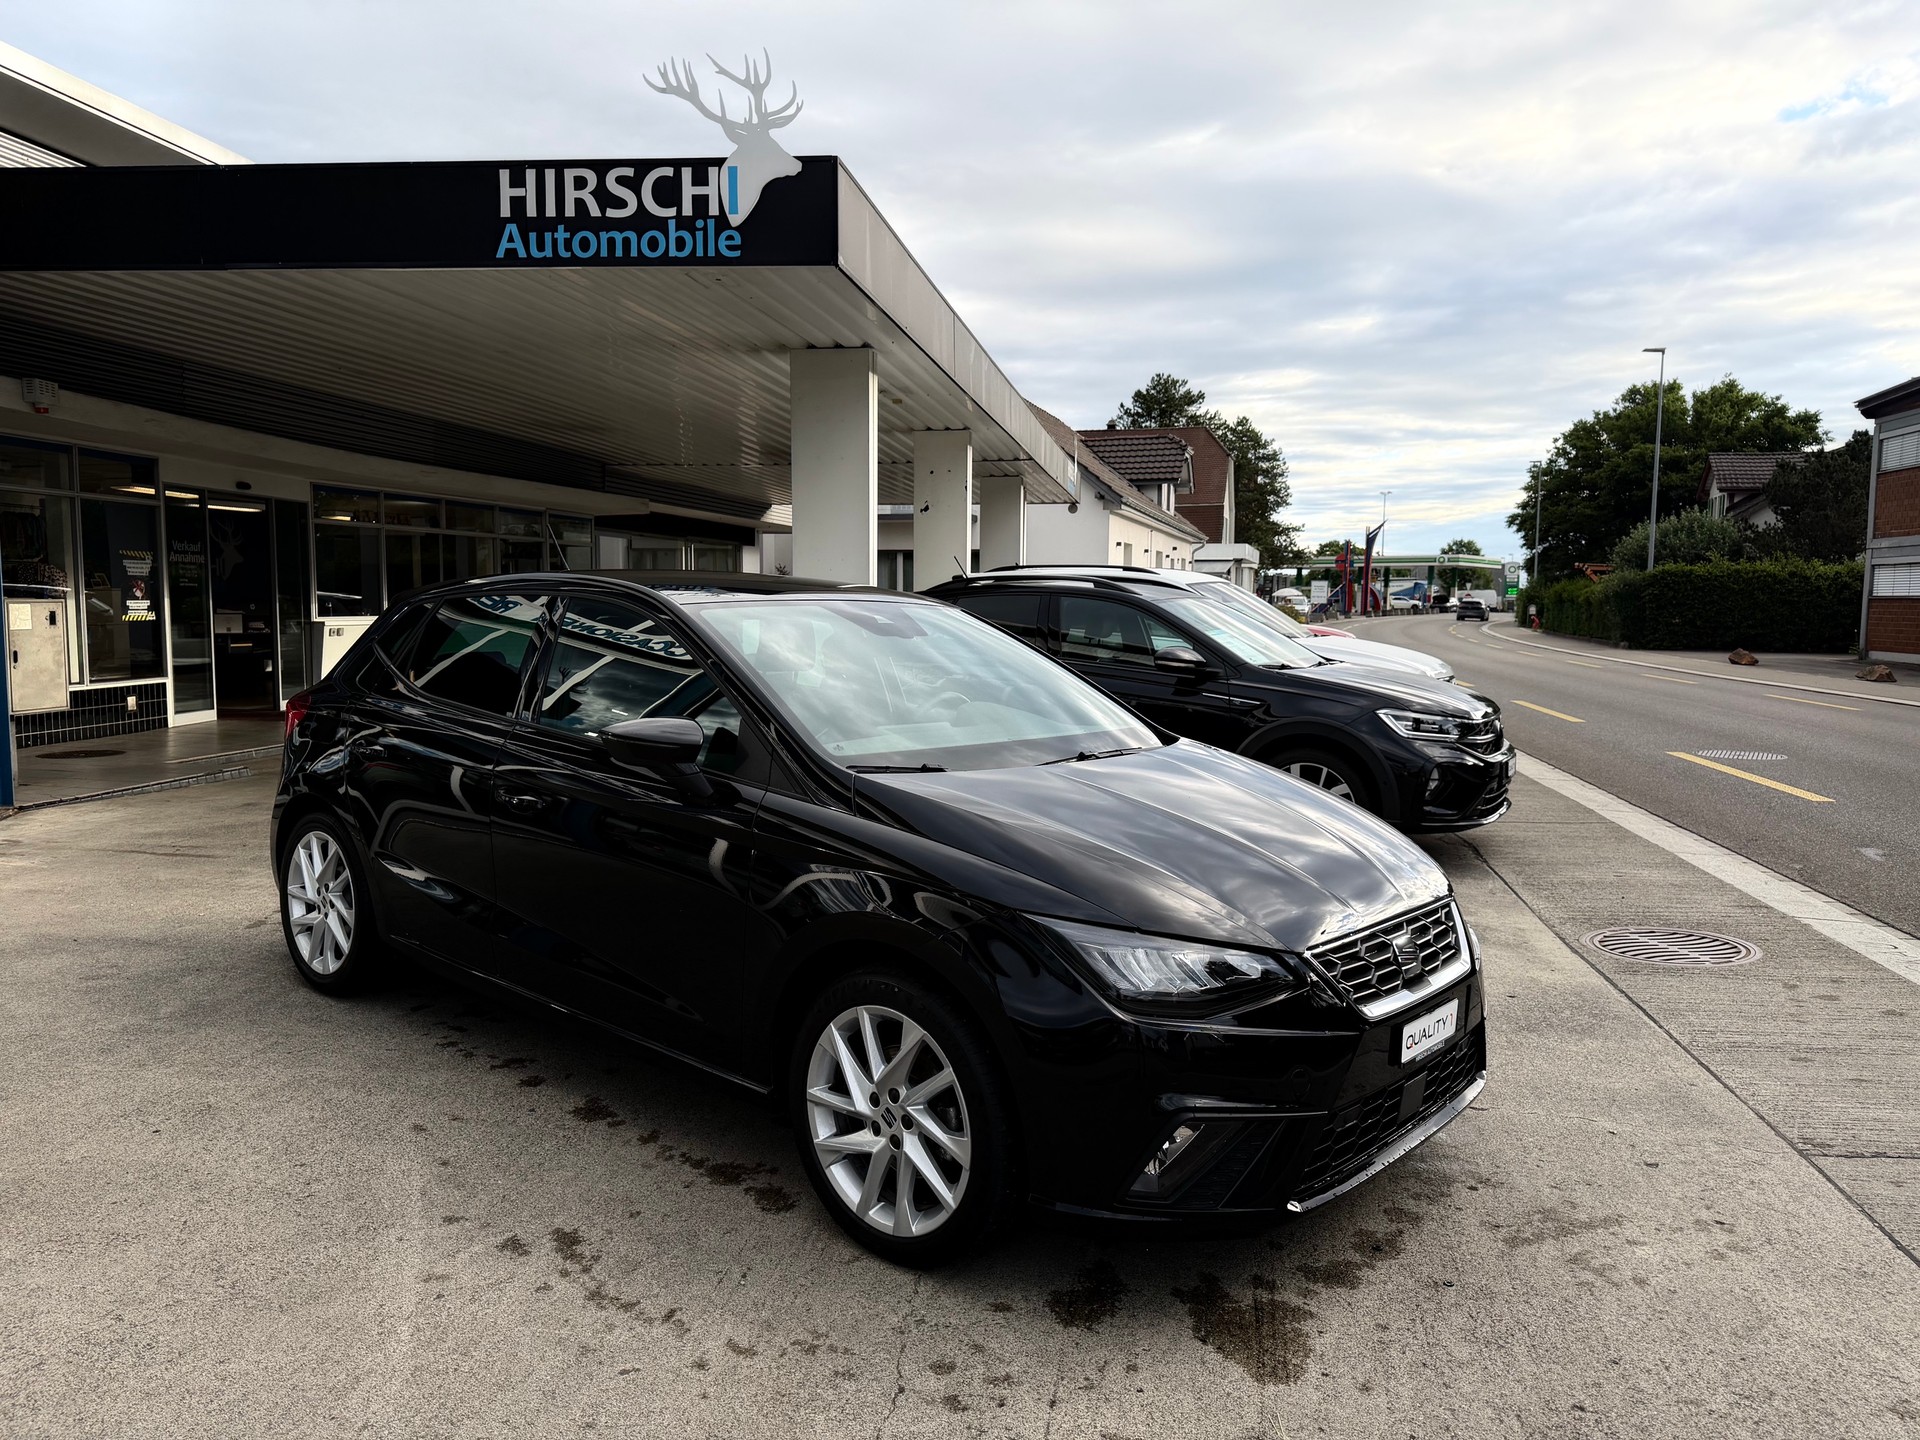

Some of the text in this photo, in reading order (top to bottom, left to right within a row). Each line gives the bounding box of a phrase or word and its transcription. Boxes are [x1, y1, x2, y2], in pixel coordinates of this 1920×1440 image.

[496, 218, 742, 258] Automobile
[170, 552, 204, 563] Annahme
[172, 540, 201, 552] Verkauf
[1406, 1015, 1448, 1049] QUALITY
